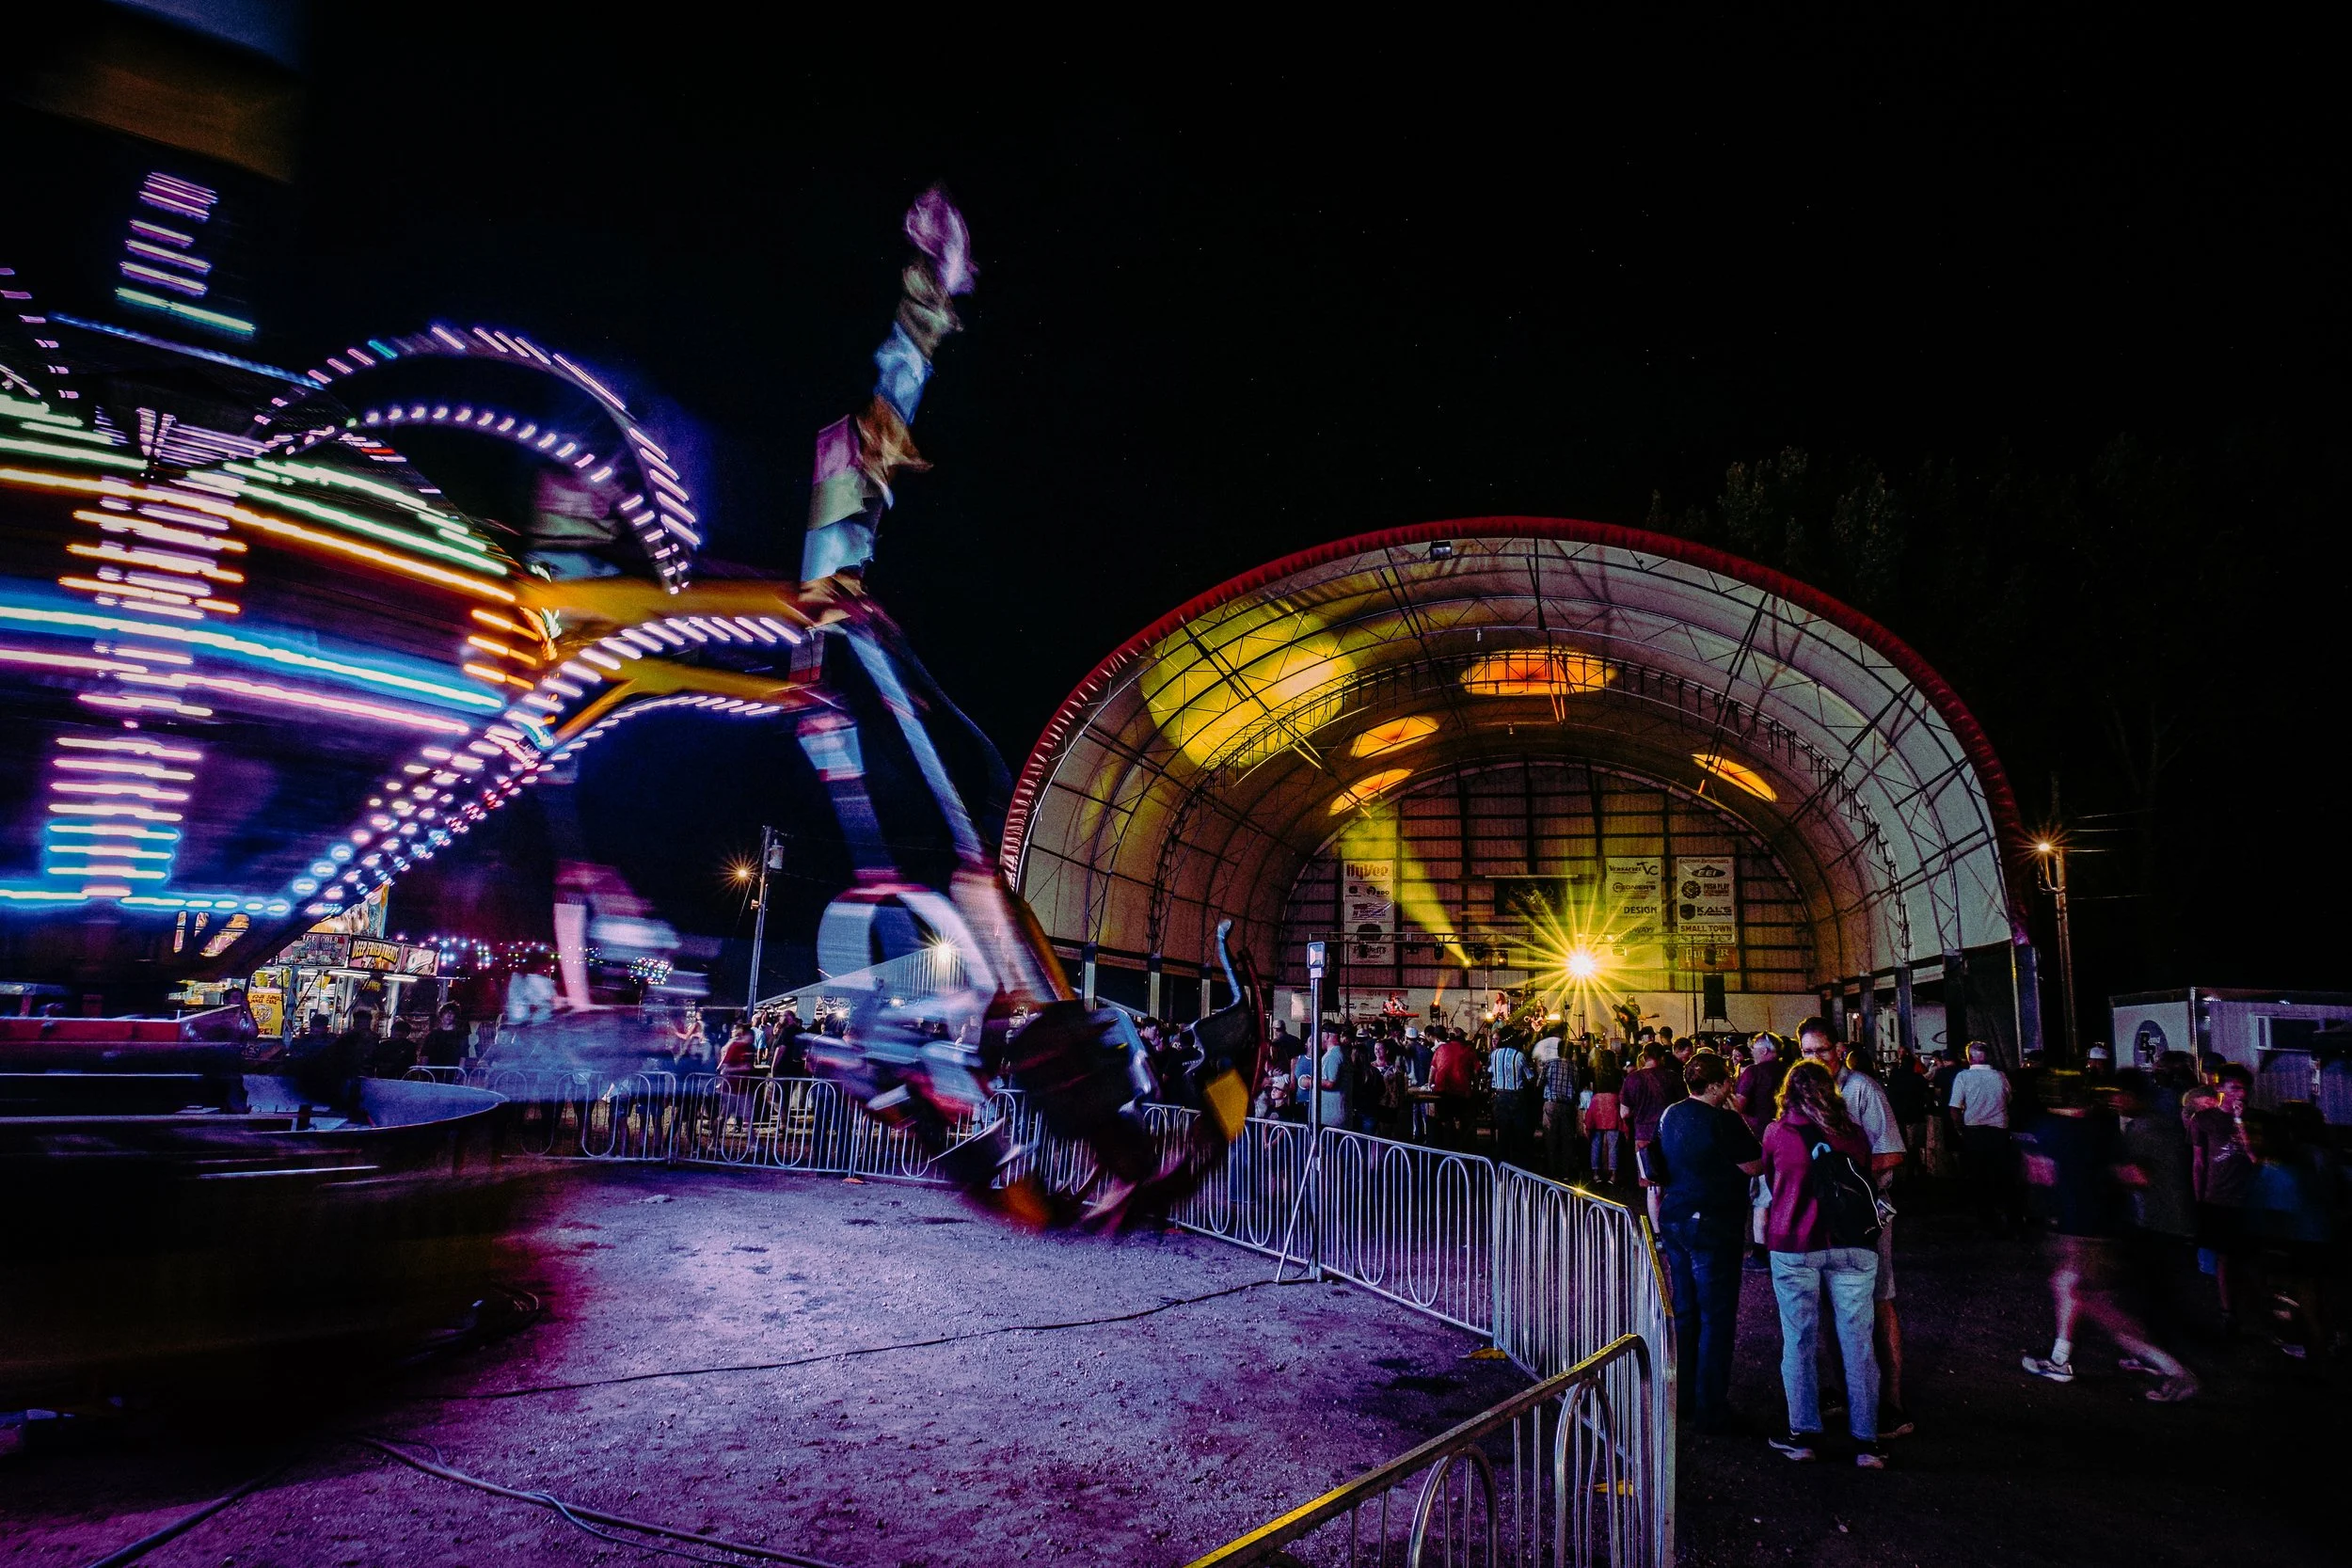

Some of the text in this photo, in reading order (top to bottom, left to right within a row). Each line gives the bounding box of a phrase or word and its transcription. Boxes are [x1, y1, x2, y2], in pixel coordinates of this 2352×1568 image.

[1623, 906, 1658, 914] DESIGN
[351, 940, 368, 959] DEEP
[367, 941, 382, 957] FRIED
